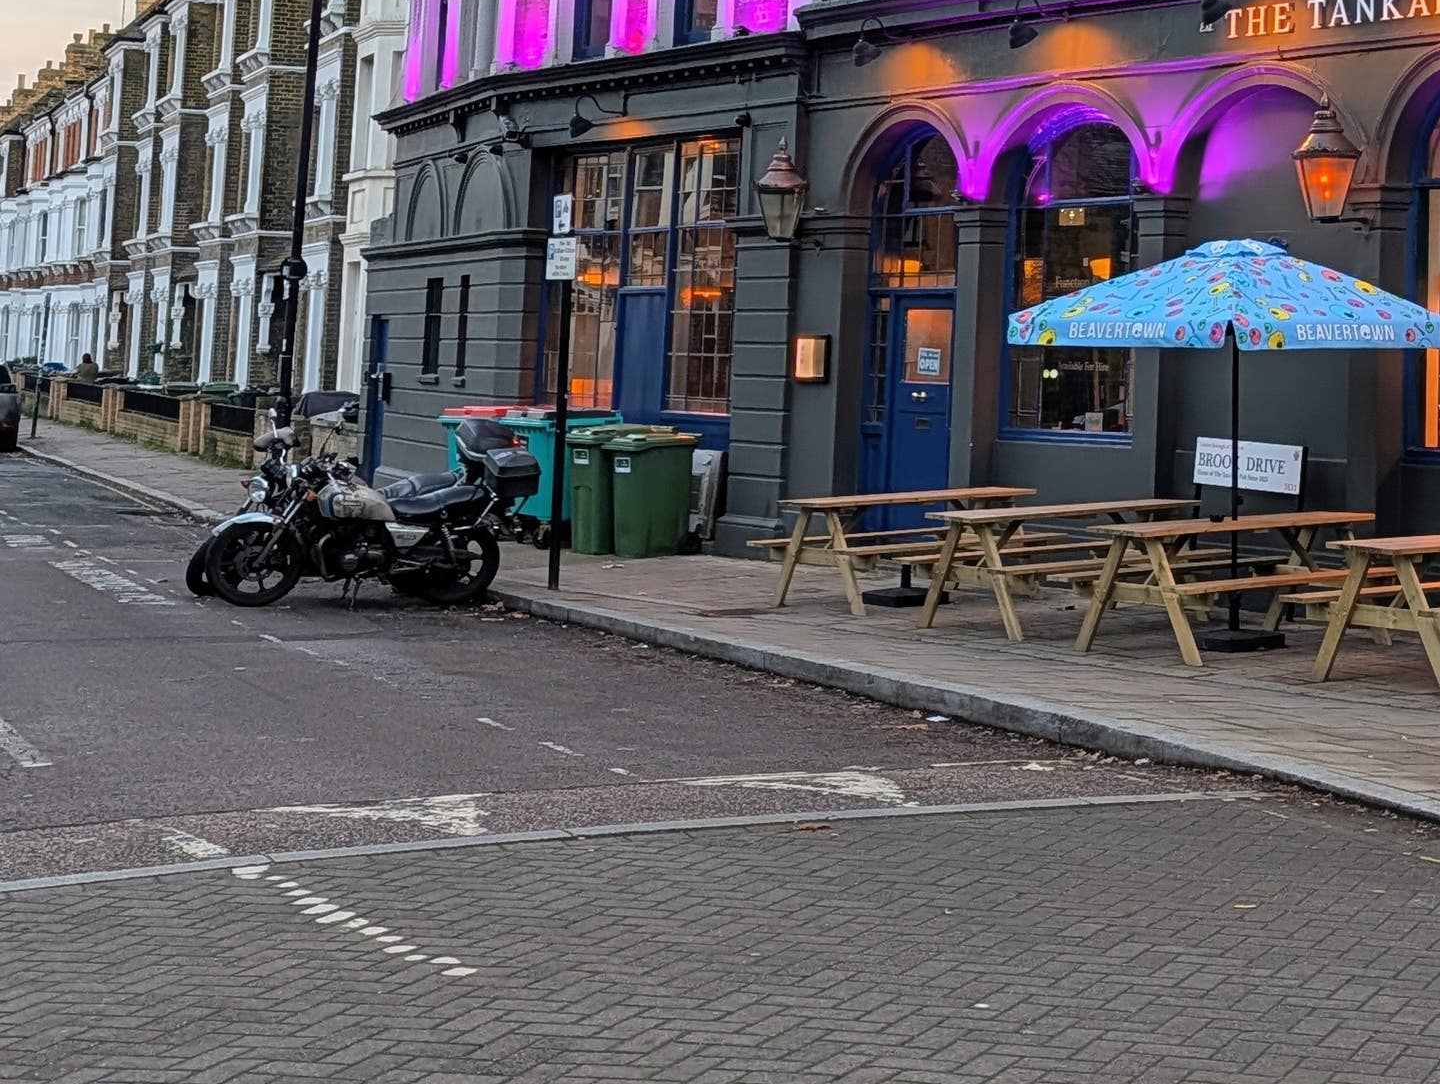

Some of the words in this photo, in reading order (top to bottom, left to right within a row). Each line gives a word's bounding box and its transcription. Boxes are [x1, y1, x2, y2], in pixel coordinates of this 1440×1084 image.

[1224, 3, 1293, 38] THE
[1068, 321, 1167, 339] BEAVERTOWN
[1296, 324, 1395, 341] BEAVERTOWN
[919, 359, 938, 370] OPEN
[1198, 452, 1240, 470] BROO
[1246, 456, 1286, 475] DRIVE
